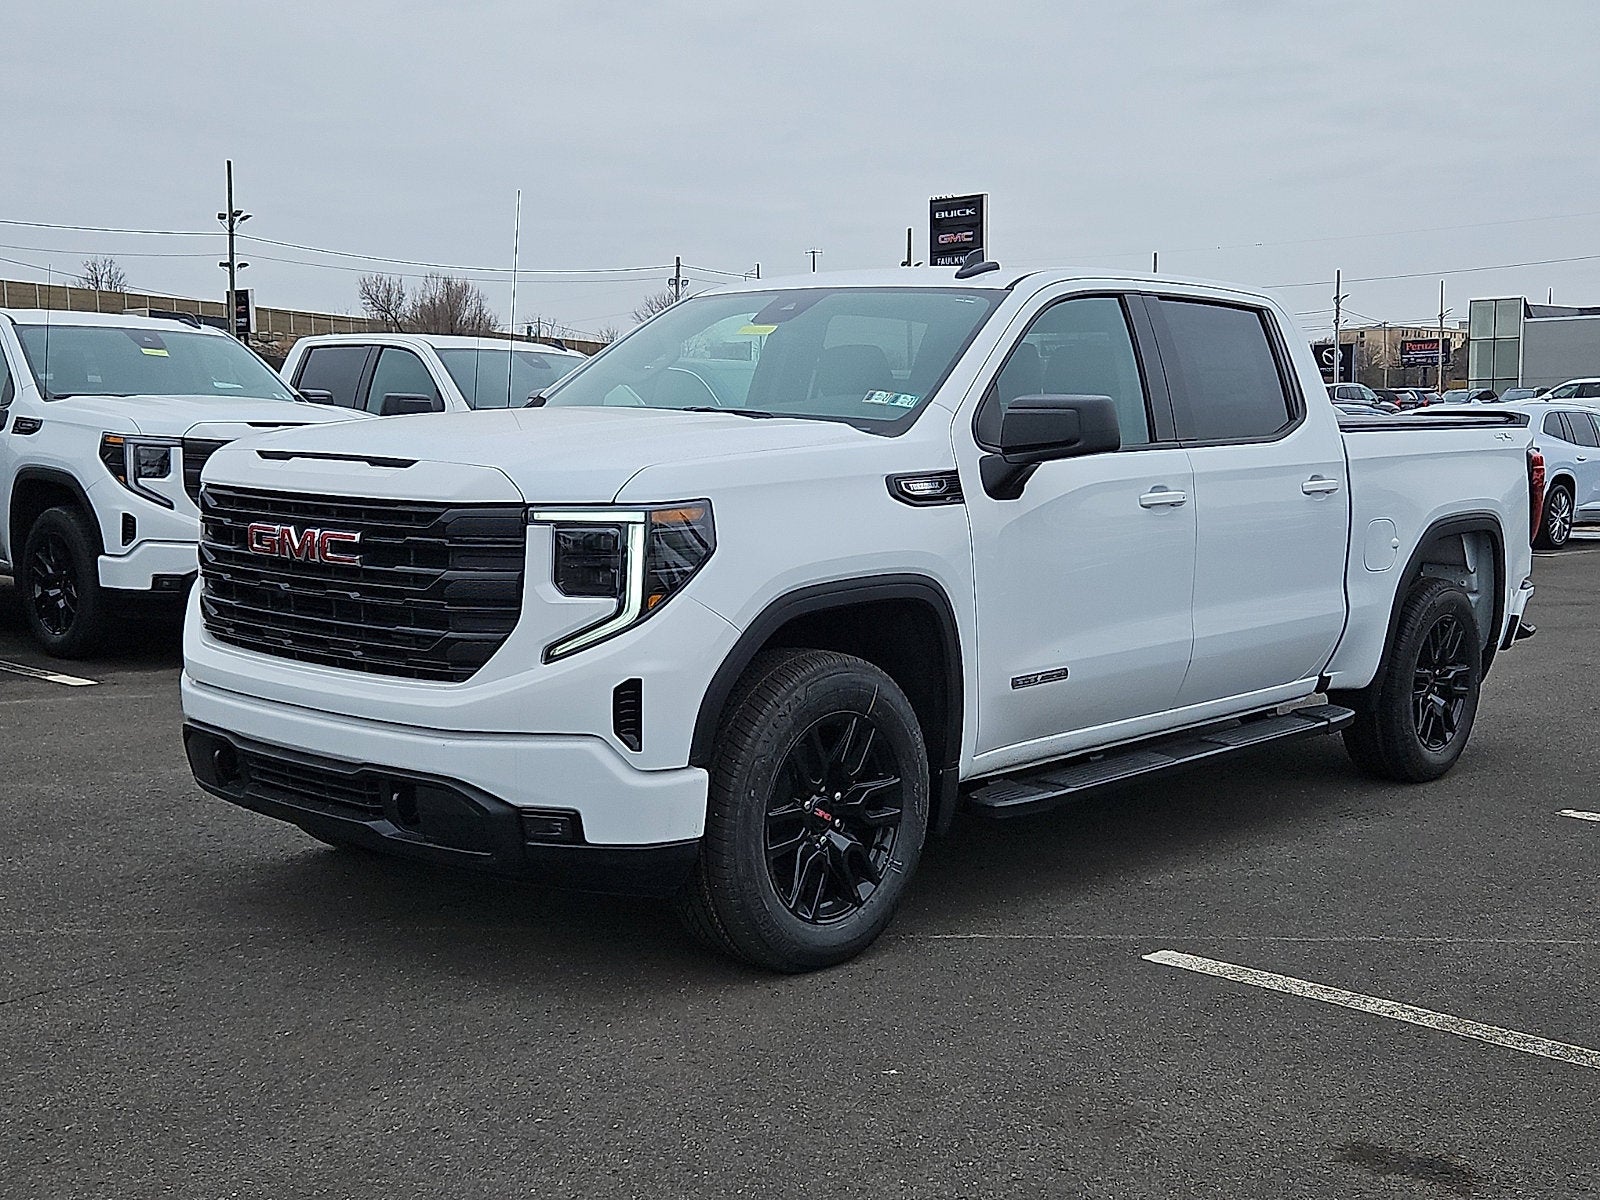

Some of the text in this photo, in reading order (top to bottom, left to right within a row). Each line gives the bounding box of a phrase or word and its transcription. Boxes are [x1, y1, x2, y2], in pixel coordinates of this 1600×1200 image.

[935, 207, 976, 219] BUICK
[938, 231, 974, 244] GMC
[1405, 342, 1440, 351] Peruzz
[248, 522, 363, 567] GMC
